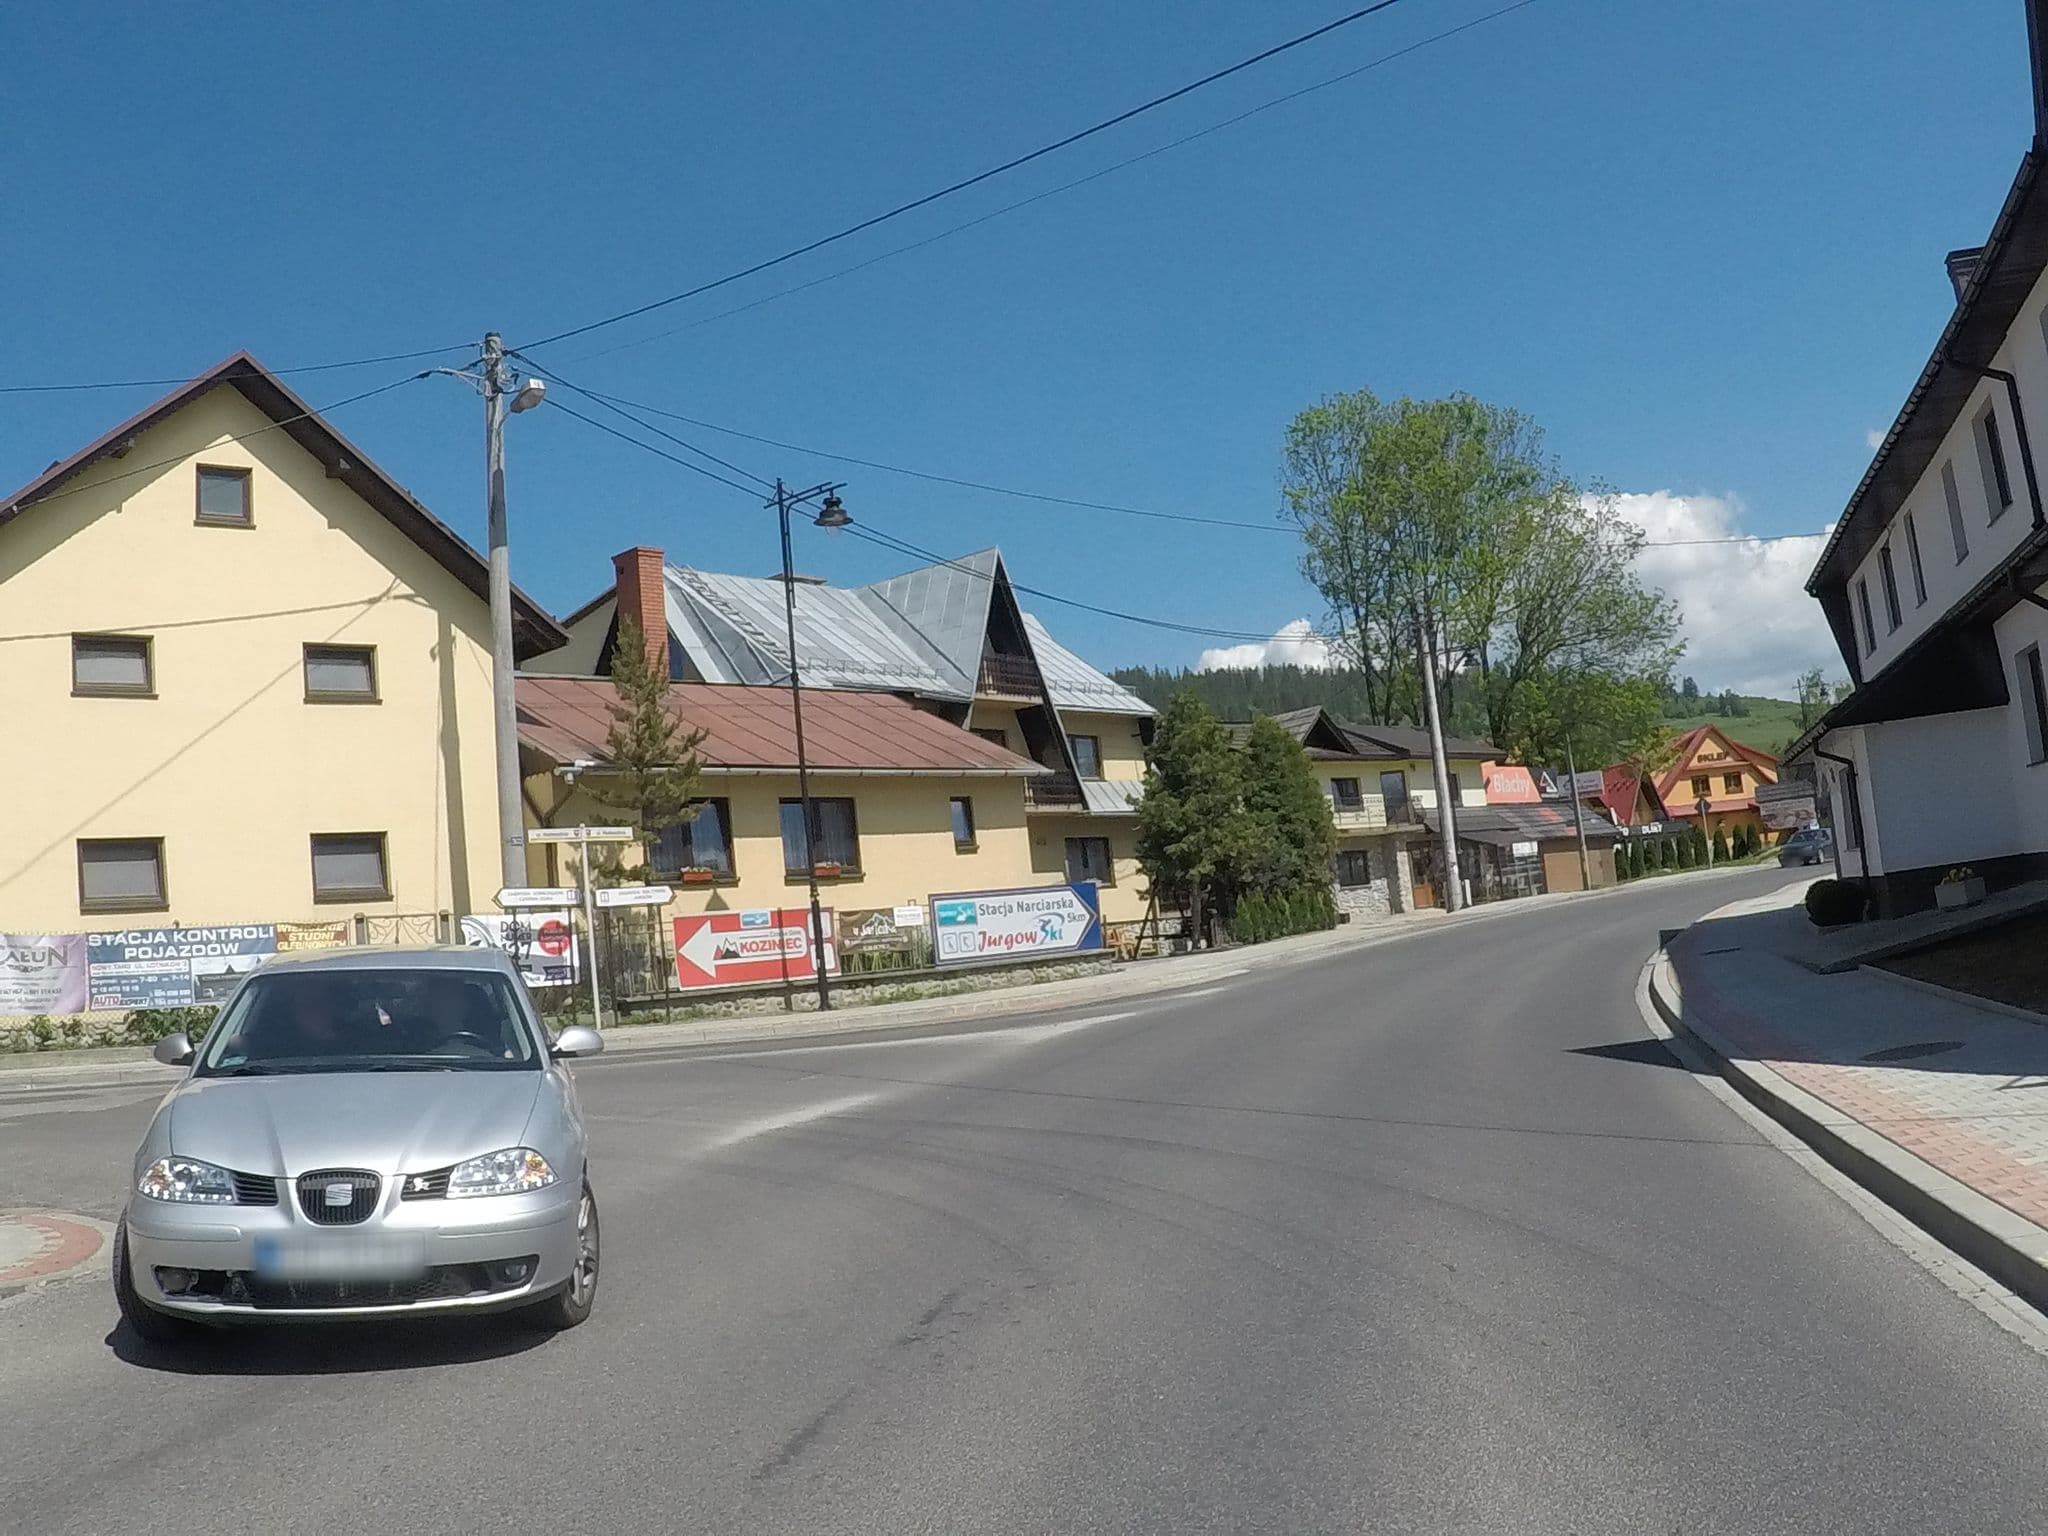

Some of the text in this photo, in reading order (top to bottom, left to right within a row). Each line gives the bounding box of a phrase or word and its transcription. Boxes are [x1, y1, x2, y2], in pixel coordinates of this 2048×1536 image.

[1493, 773, 1530, 795] Blachy
[979, 902, 1013, 917] Stacja
[1016, 897, 1074, 913] Narciarska
[1067, 912, 1087, 923] 5km
[88, 926, 275, 947] STACJA KONTROLI
[289, 931, 335, 942] STUDNI
[740, 937, 803, 953] KOZINEC
[124, 941, 240, 960] POJAZDÓW
